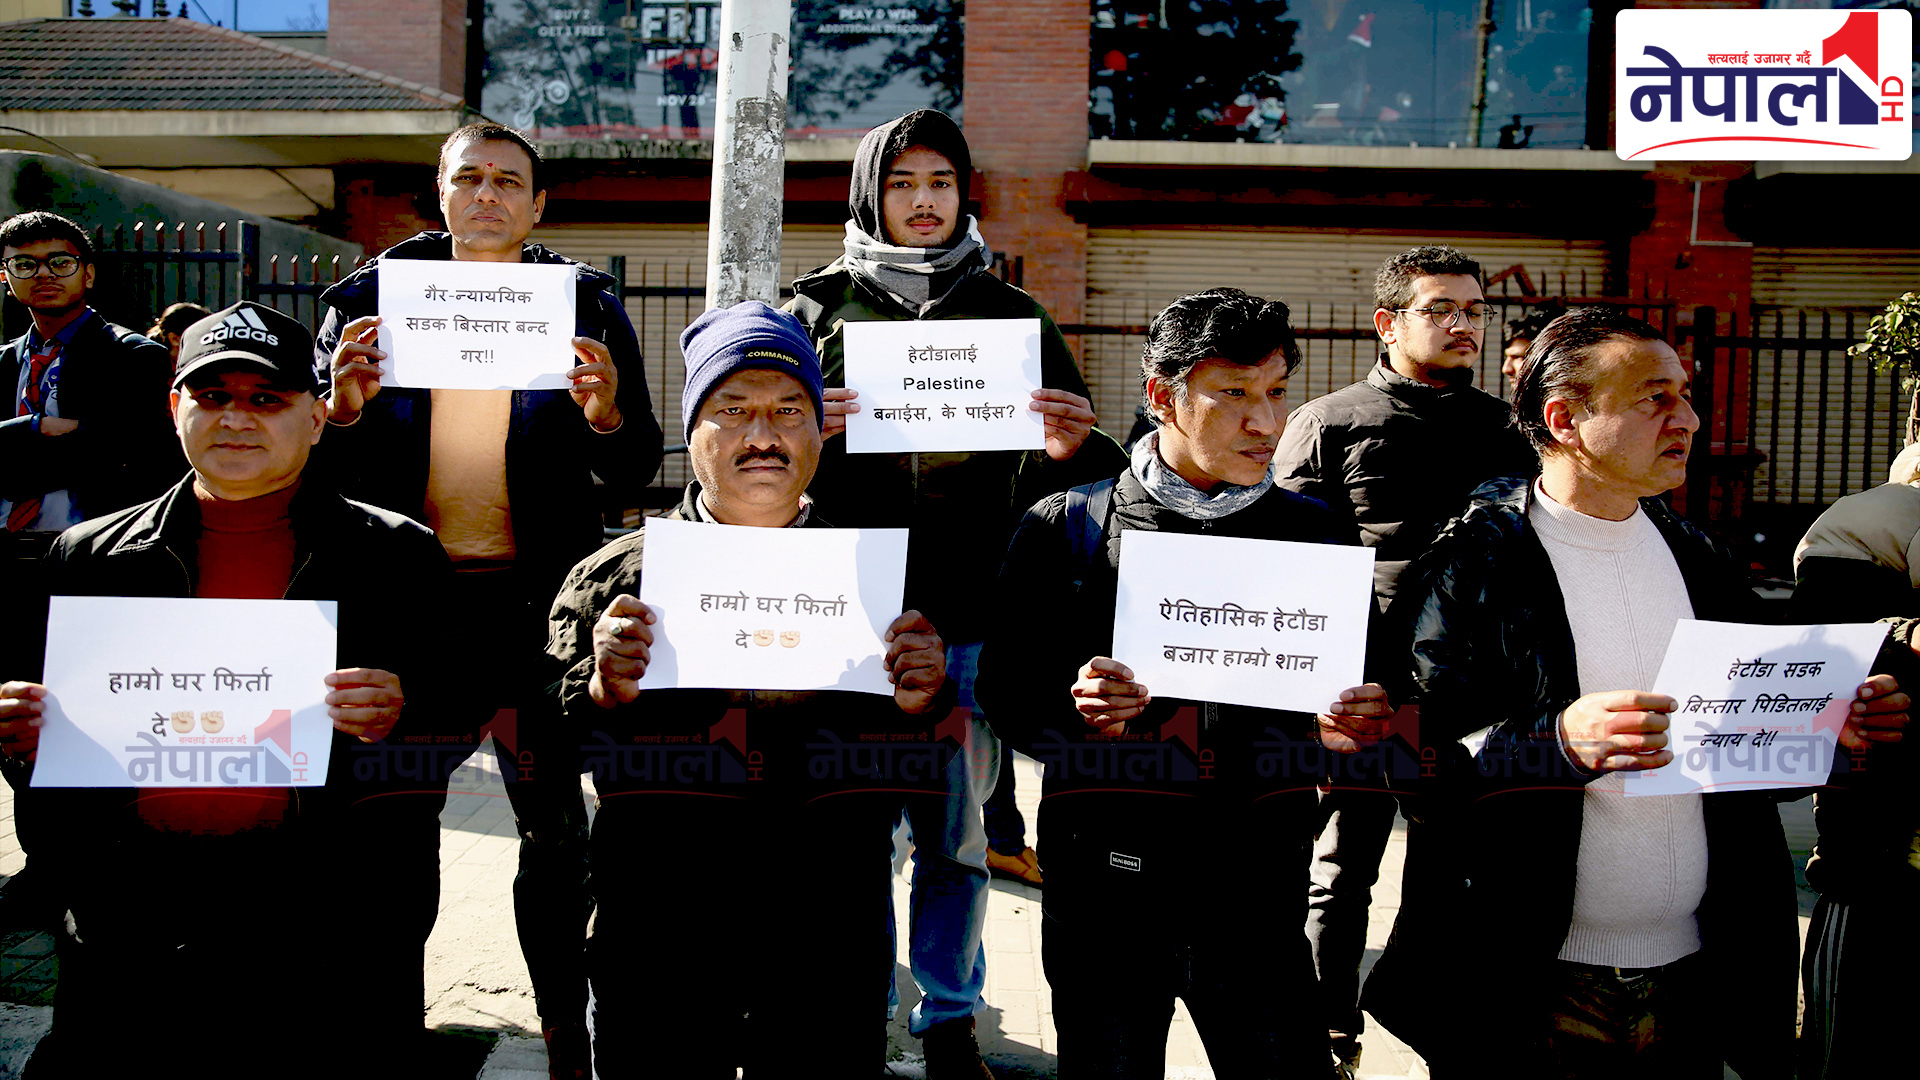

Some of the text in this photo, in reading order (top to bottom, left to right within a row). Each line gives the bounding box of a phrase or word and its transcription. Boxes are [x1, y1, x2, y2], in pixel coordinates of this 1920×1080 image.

[838, 8, 875, 20] PLAY
[887, 9, 917, 20] WIN
[538, 25, 564, 38] GET
[573, 25, 606, 38] FREE
[883, 23, 940, 34] DISCOUNT
[406, 315, 548, 335] सडक बिस्तार बन्द
[200, 326, 279, 346] adidas
[461, 350, 493, 363] गर!!
[909, 344, 978, 363] हेटौडालाई
[904, 377, 985, 390] Palestine
[942, 404, 956, 419] के
[966, 402, 1015, 421] पाईस?
[701, 591, 847, 616] हाम्रो घर फिर्ता
[1159, 598, 1328, 631] ऐतिहासिक हेटौडा
[735, 629, 751, 648] दे
[1163, 645, 1318, 671] बजार हाम्रो शान
[1727, 658, 1825, 680] हेटौडा सडक
[109, 667, 272, 693] हाम्रो घर फिर्ता
[152, 712, 169, 736] दे
[1700, 728, 1779, 748] न्याय दे!!
